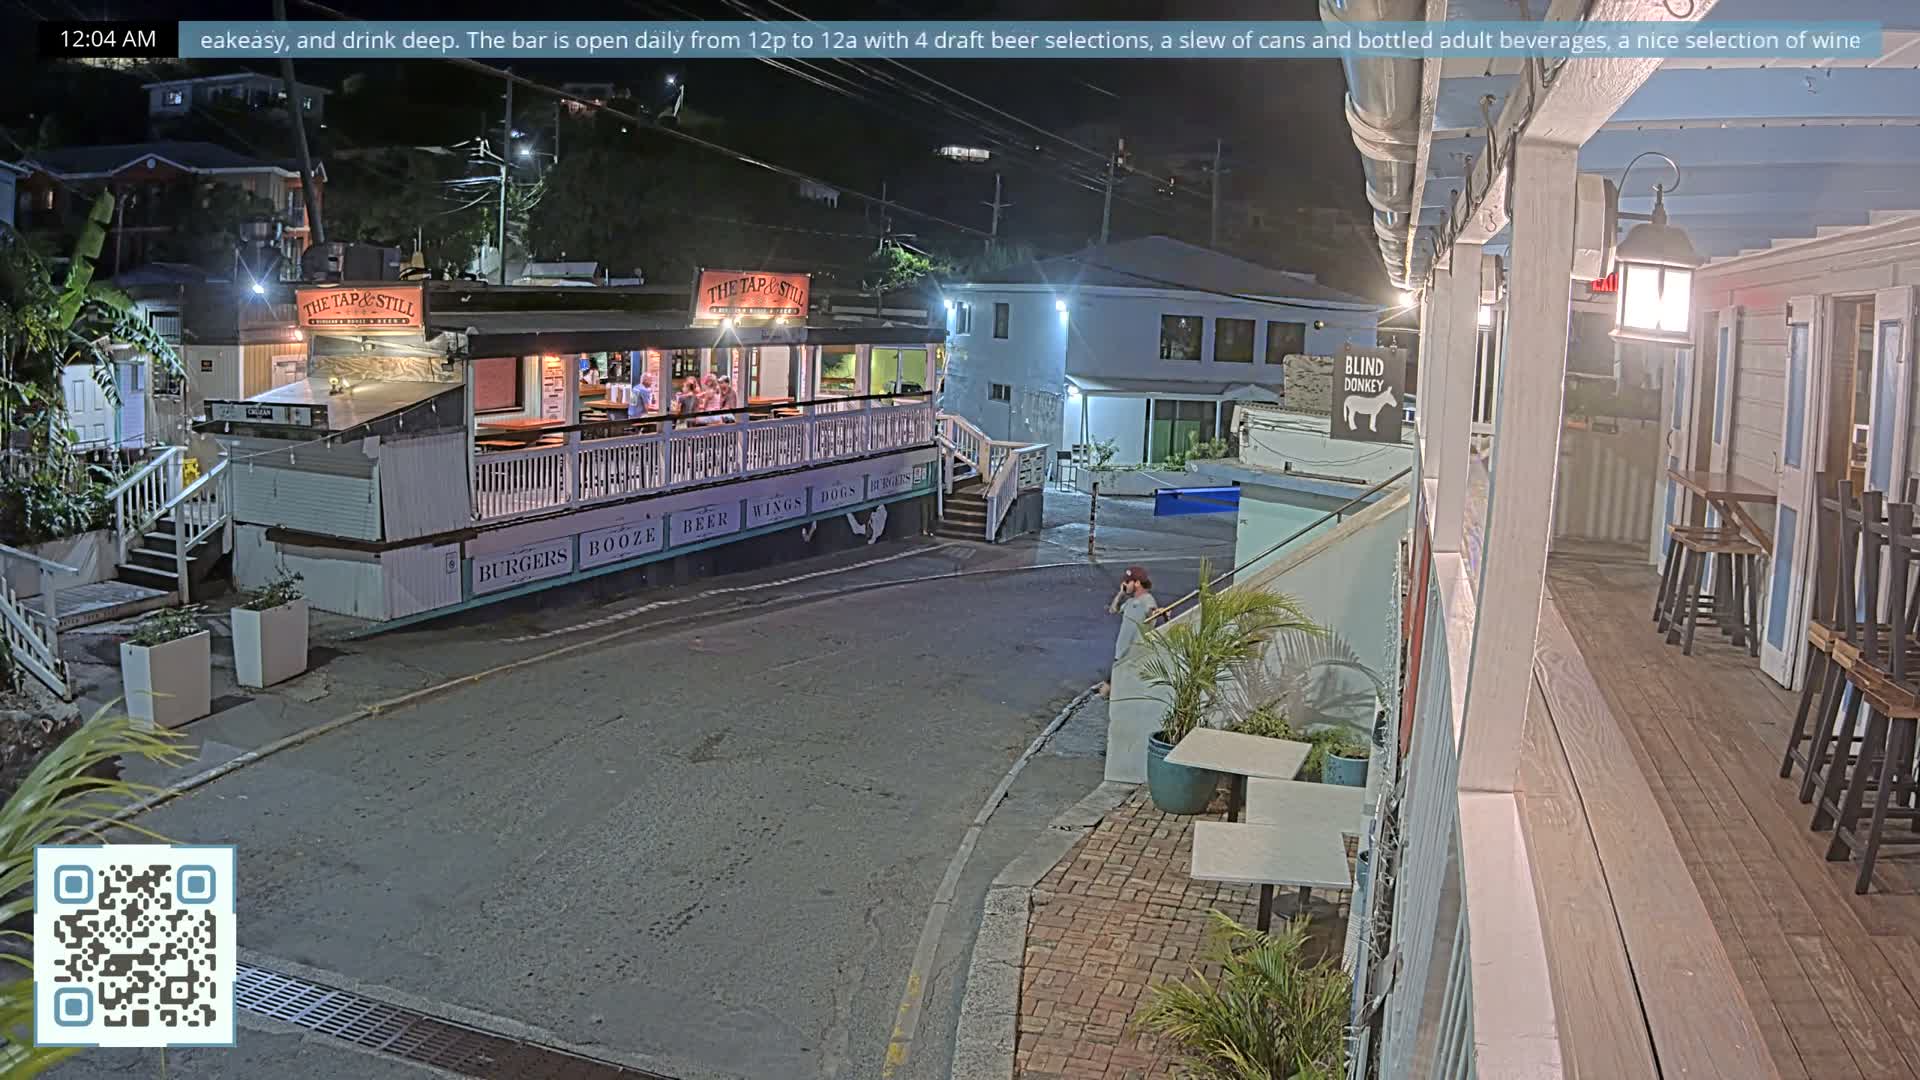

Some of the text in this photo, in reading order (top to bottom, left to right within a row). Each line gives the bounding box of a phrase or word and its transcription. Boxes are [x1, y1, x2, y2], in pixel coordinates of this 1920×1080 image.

[708, 280, 738, 304] THE
[740, 277, 766, 294] TAP
[779, 280, 803, 307] STILL
[303, 297, 331, 317] THE
[331, 292, 360, 307] TAP
[376, 293, 415, 317] STILL
[1345, 355, 1385, 377] BLIND
[1344, 376, 1385, 393] DONKEY
[870, 473, 911, 492] BURGERS
[821, 486, 856, 503] DOGS
[753, 497, 801, 517] WINGS
[683, 511, 728, 534] BEER
[589, 527, 656, 557] BOOZE
[479, 548, 568, 583] BURGERS
